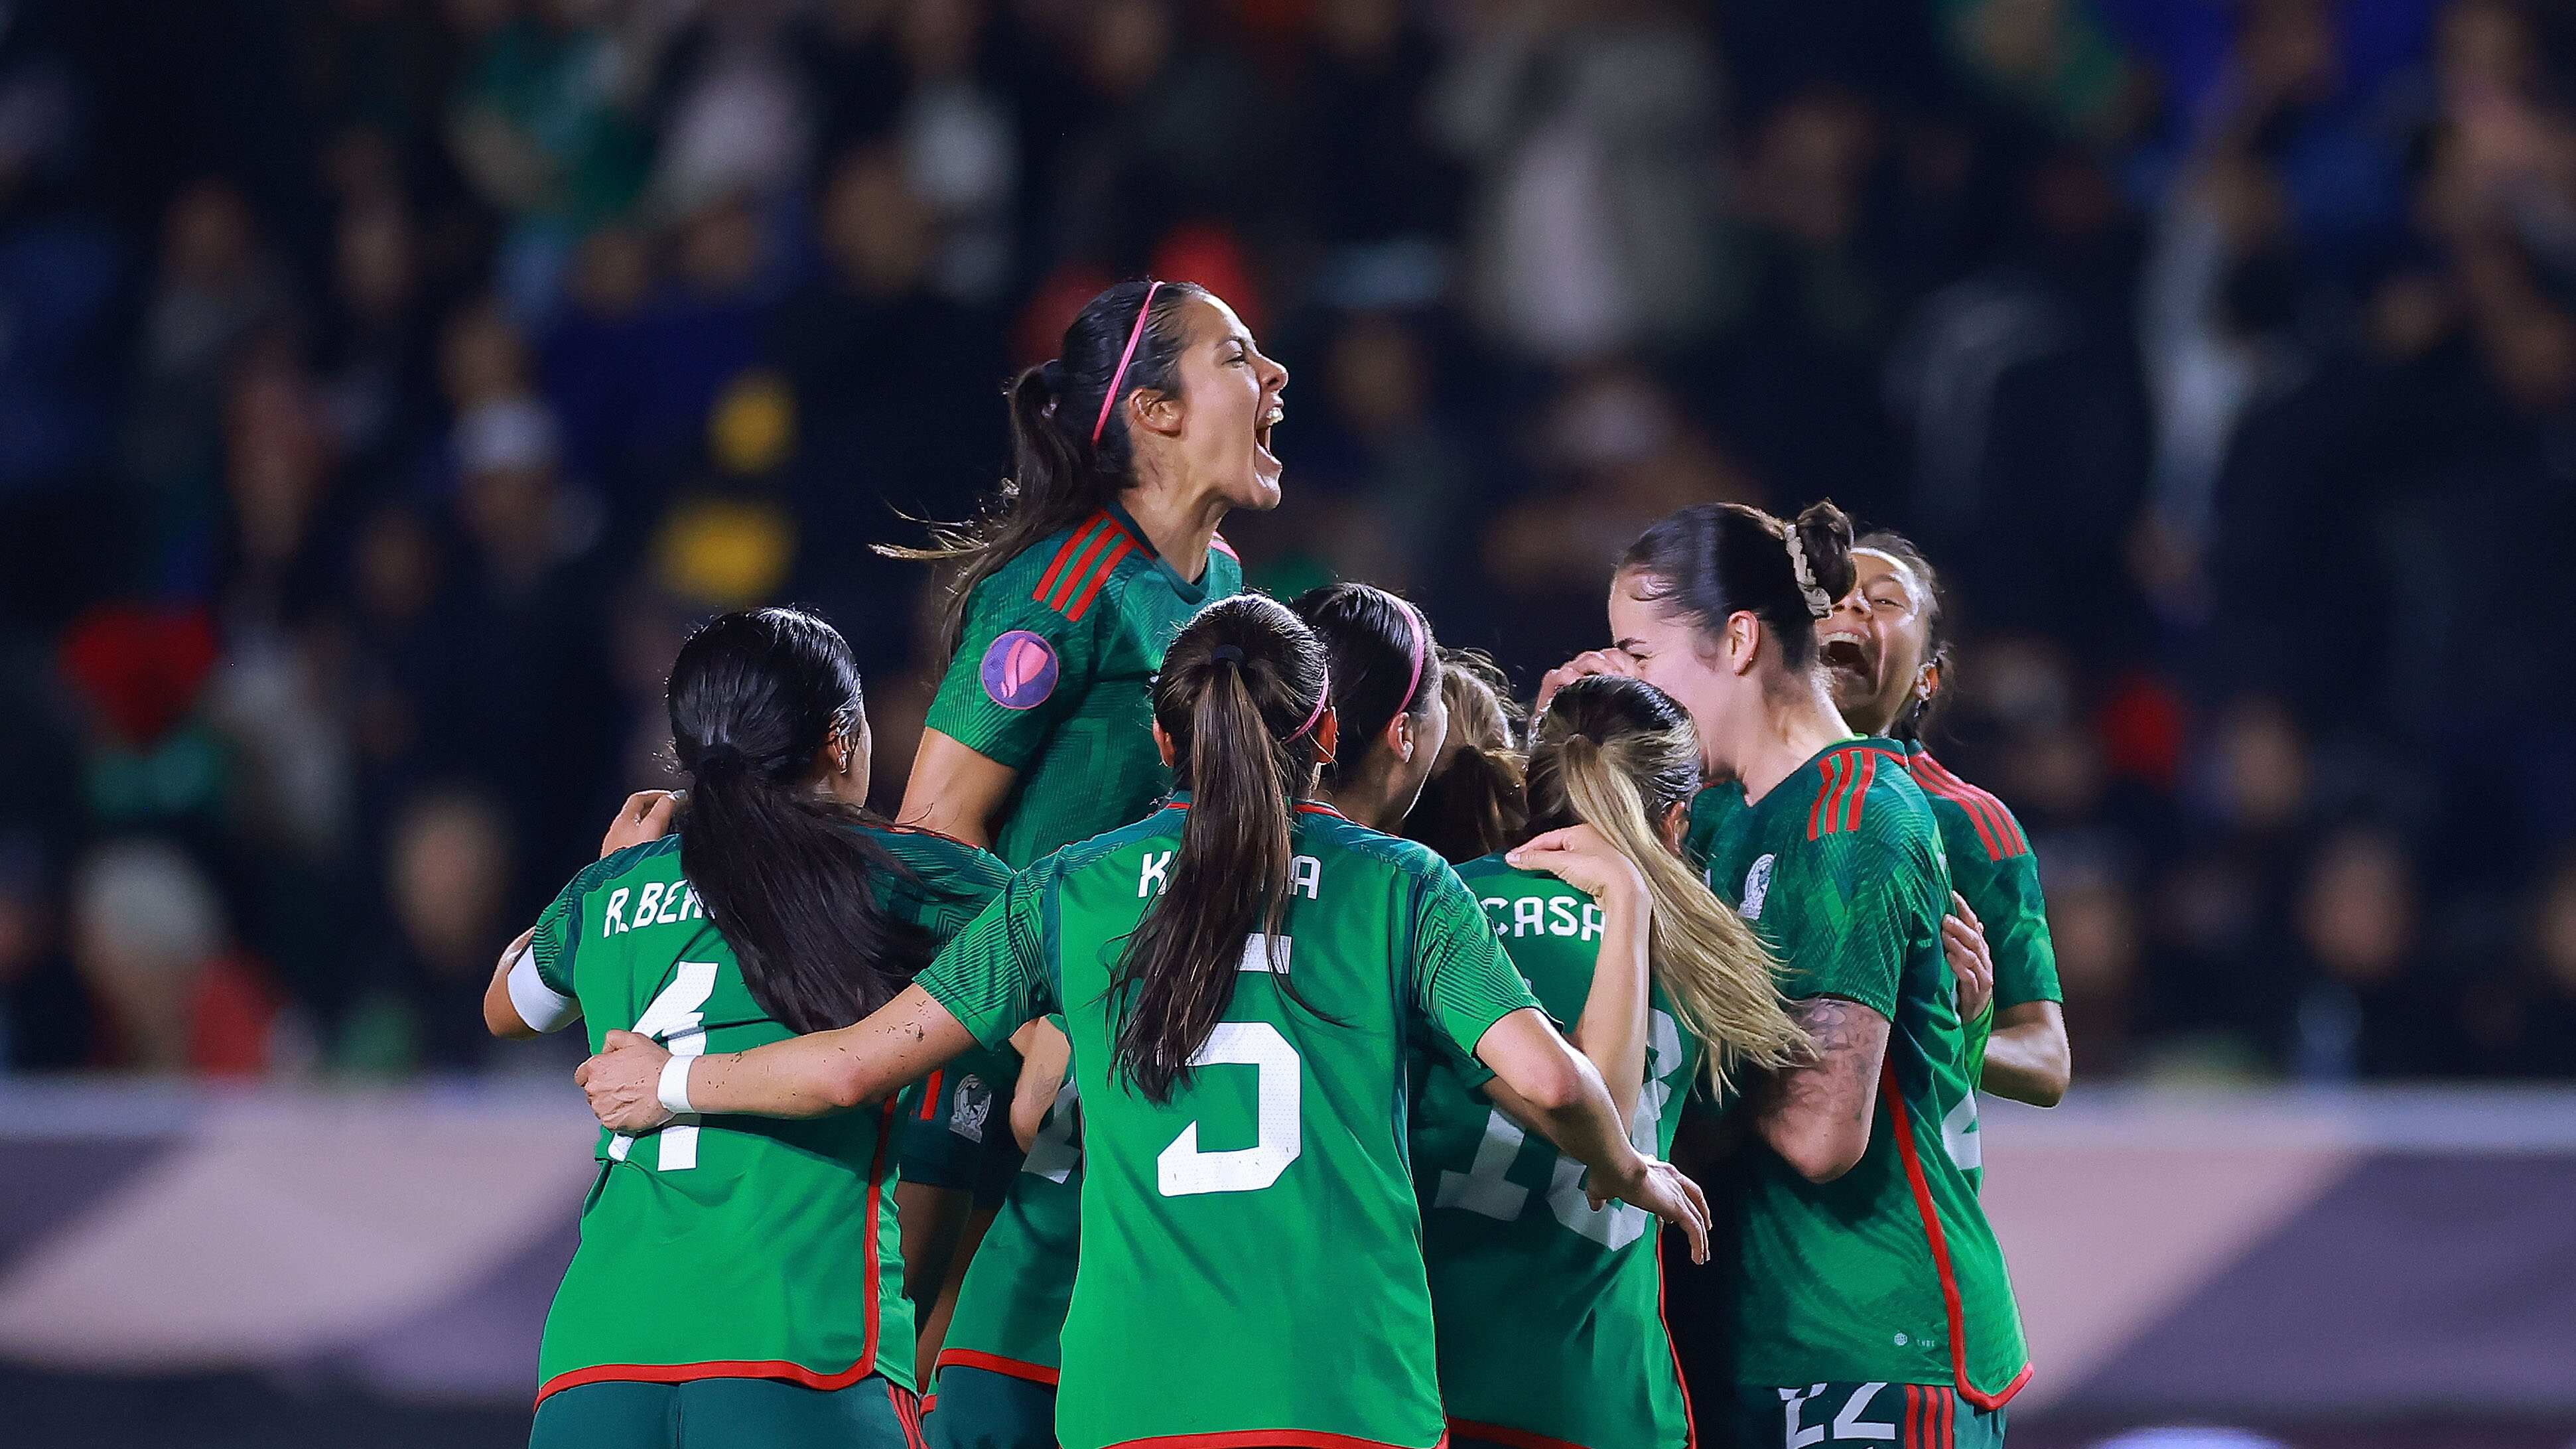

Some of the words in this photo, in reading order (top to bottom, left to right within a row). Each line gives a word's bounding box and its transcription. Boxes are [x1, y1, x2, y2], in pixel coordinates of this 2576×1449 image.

[1480, 896, 1607, 941] CASA
[608, 961, 720, 1172] 4
[1157, 932, 1302, 1197] 5
[1778, 1381, 1896, 1449] 22
